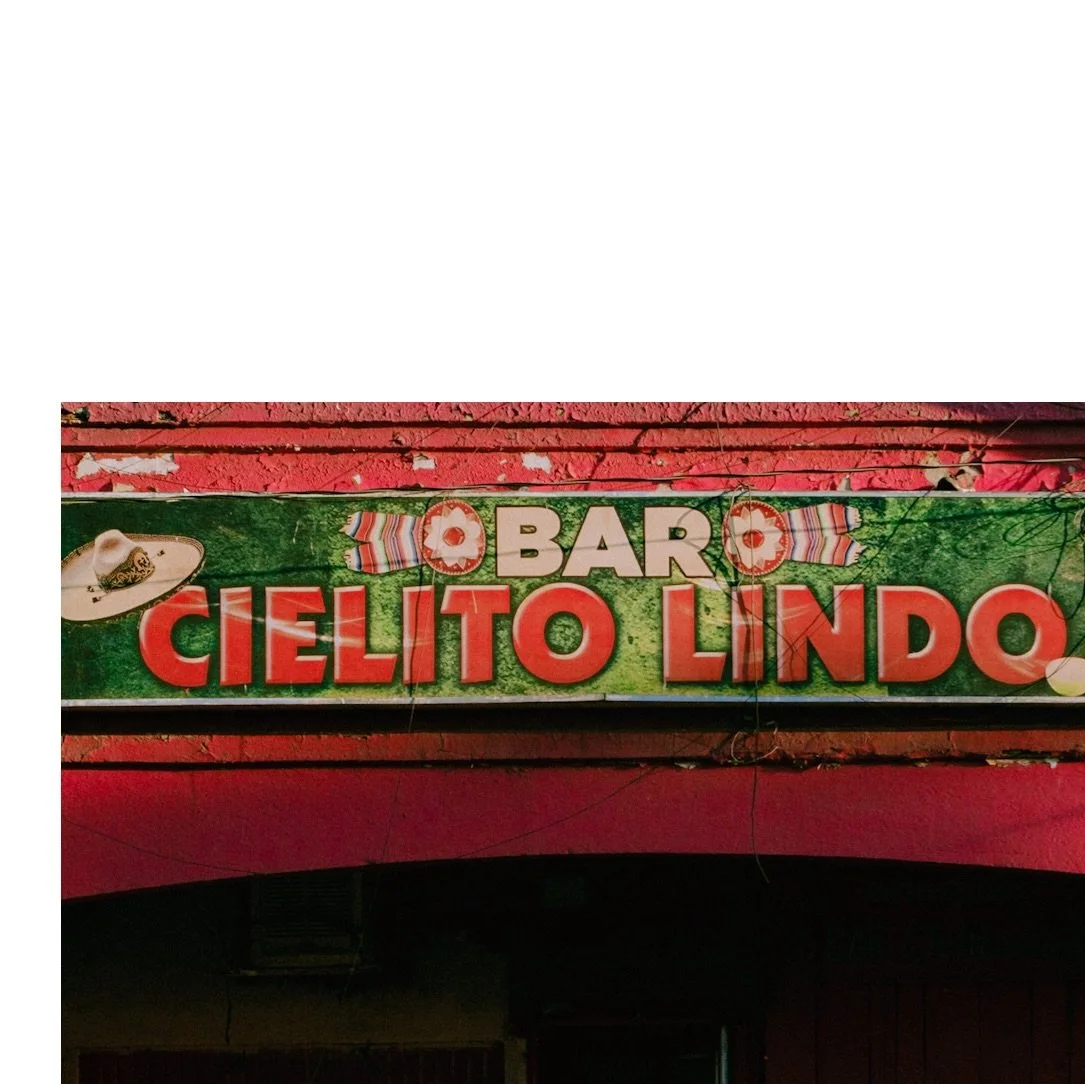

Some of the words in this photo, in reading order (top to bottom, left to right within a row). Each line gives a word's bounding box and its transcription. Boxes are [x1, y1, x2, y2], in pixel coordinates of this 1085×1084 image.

[495, 505, 713, 577] BAR
[139, 582, 616, 687] CIELITO
[661, 582, 1067, 686] LINDO
